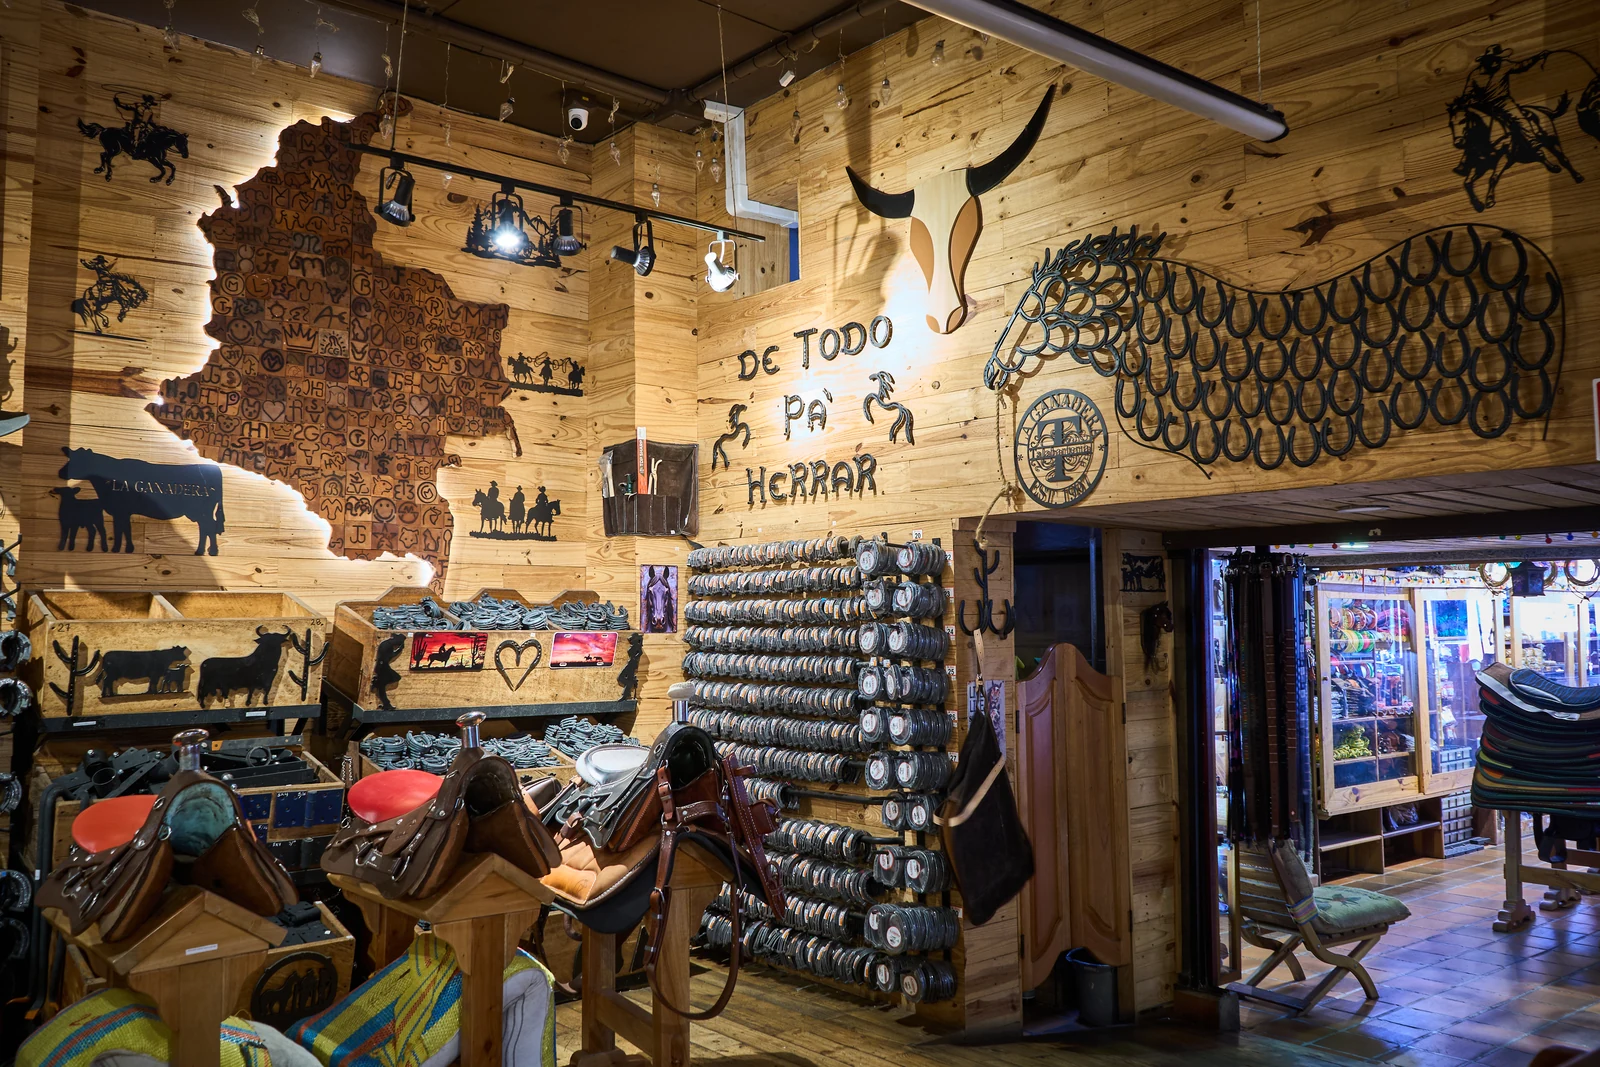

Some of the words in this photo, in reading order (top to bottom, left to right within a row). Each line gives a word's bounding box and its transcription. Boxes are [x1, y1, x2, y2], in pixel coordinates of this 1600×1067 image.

[737, 345, 780, 381] DE
[794, 315, 893, 369] TODO
[1029, 393, 1103, 440] GANADERA
[112, 479, 130, 492] LA
[134, 481, 209, 497] GANADERA
[746, 453, 877, 505] HERRAR
[58, 623, 71, 632] 27
